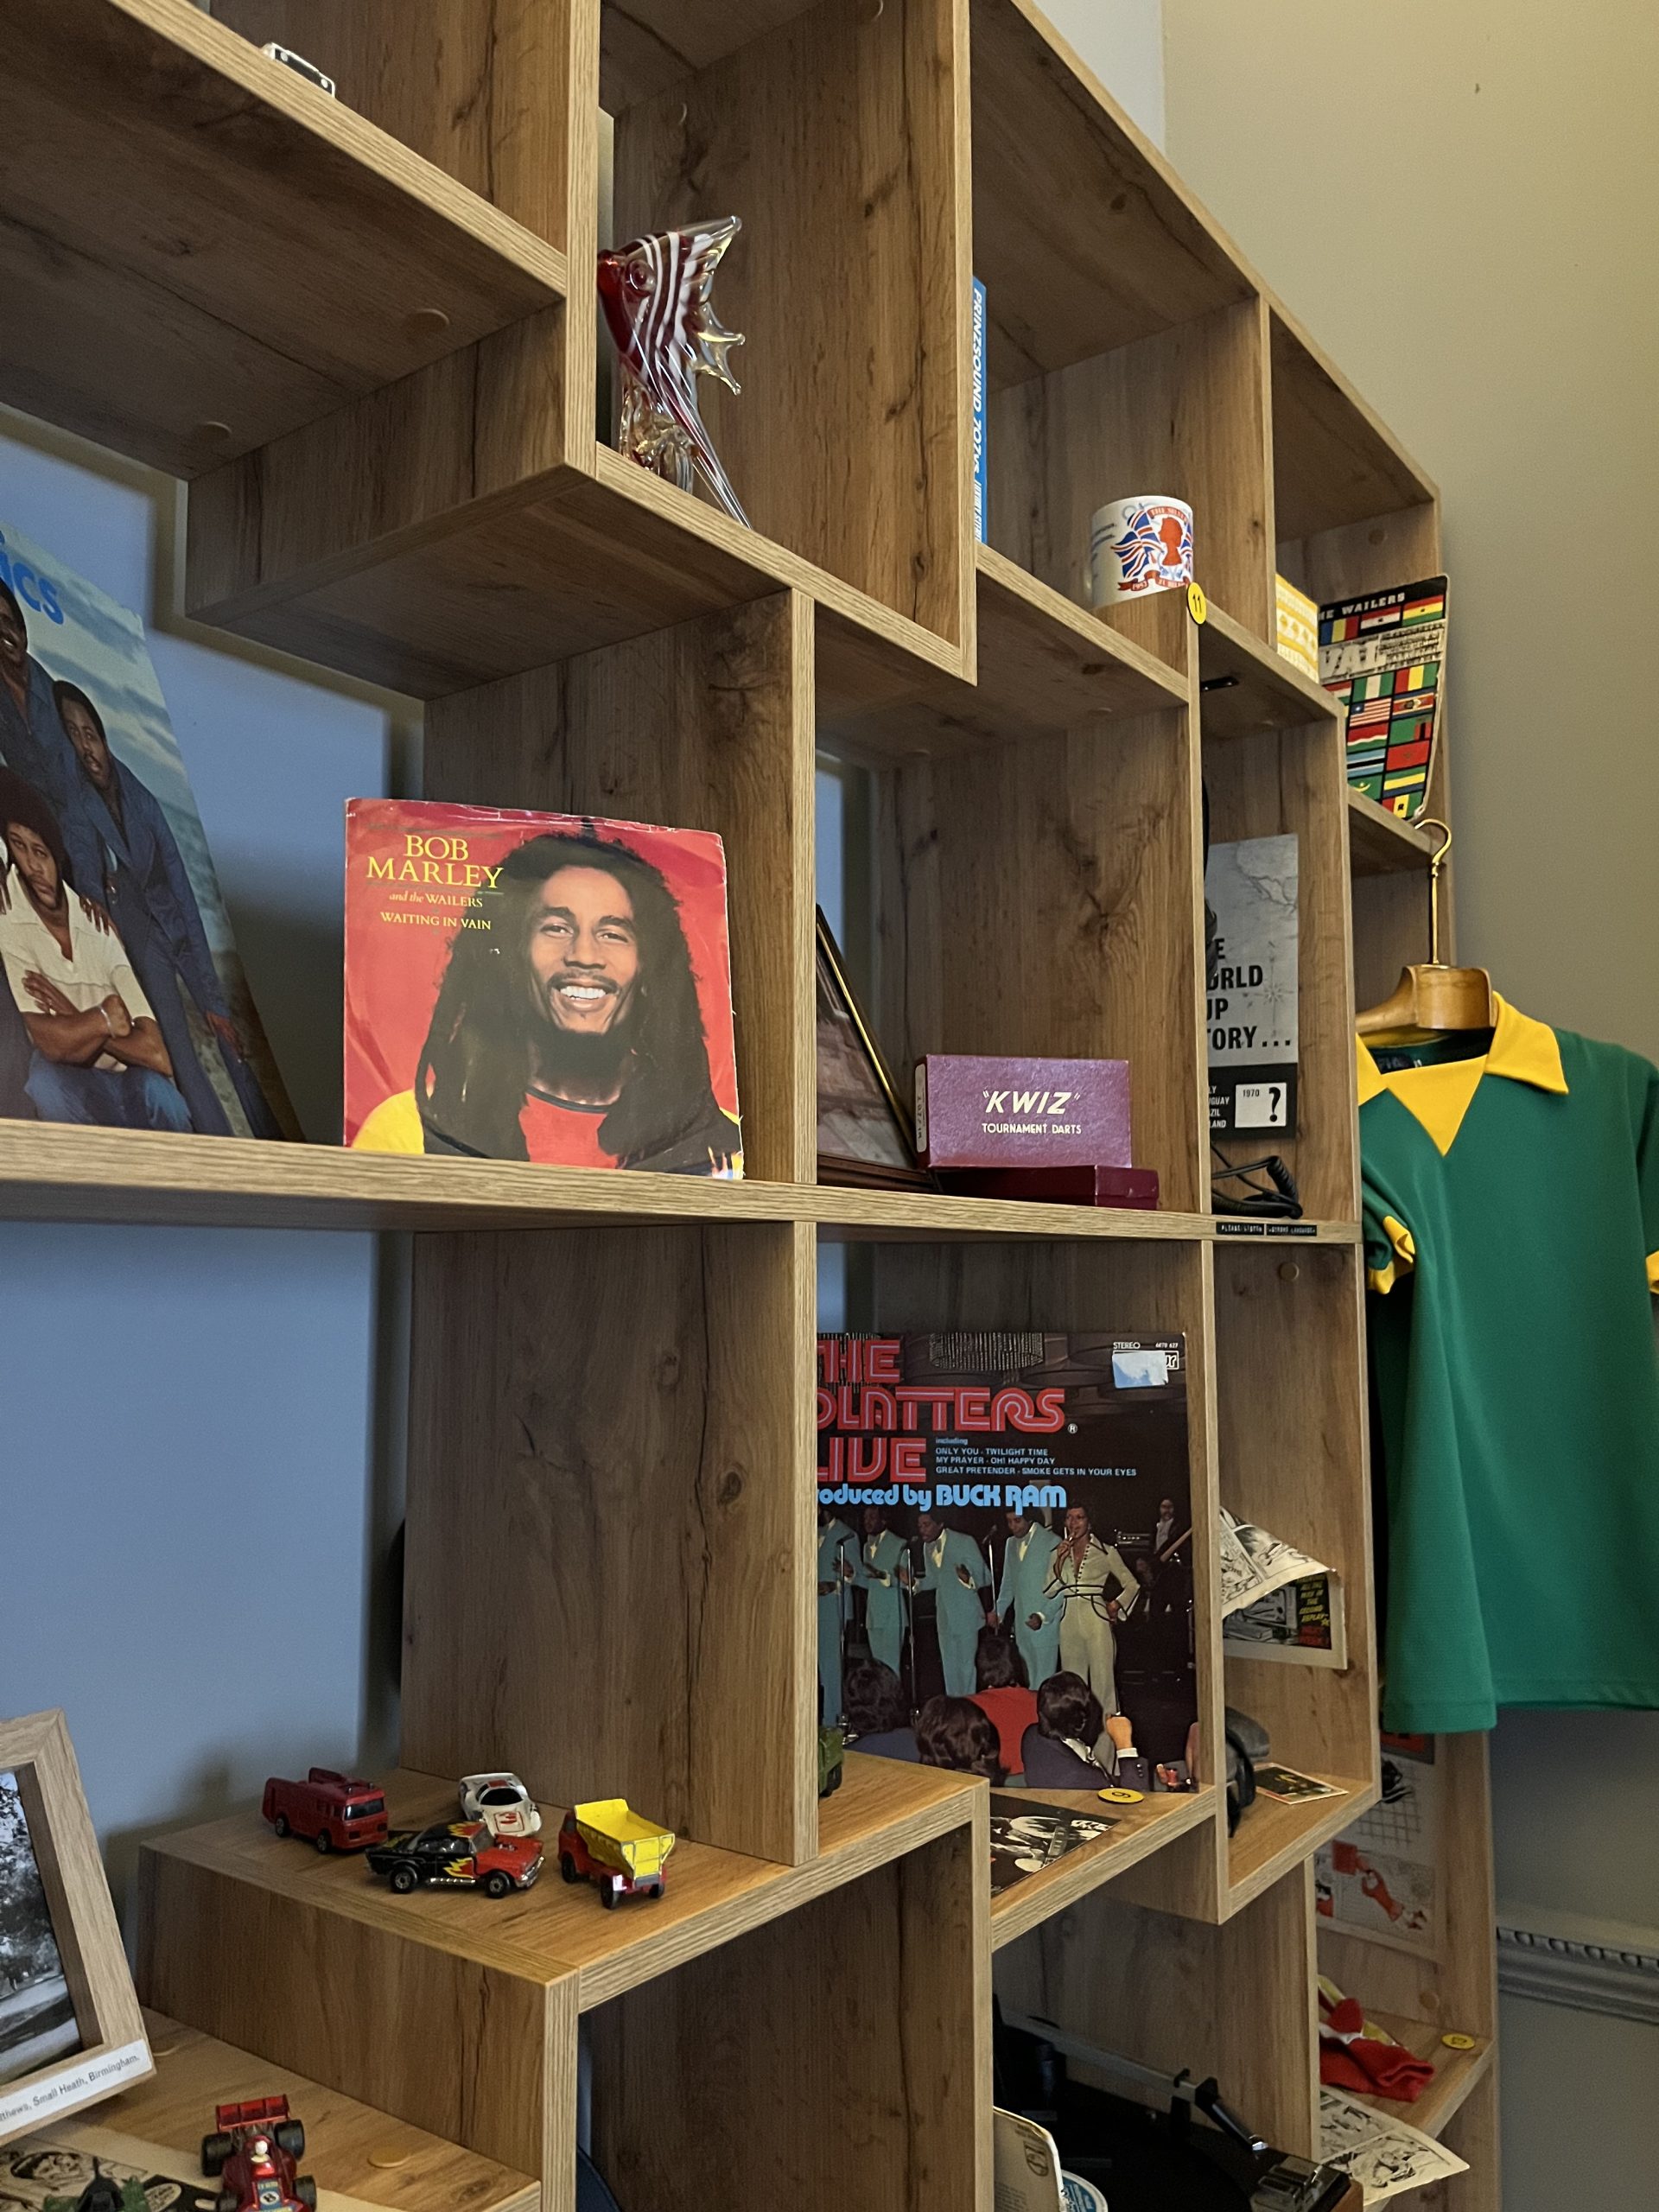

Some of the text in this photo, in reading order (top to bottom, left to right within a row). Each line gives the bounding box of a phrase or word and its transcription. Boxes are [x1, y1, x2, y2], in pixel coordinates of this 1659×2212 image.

[973, 288, 982, 412] PRINZSOUND
[1342, 592, 1406, 614] WAILERS
[404, 835, 468, 861] BOB
[366, 856, 505, 888] MARLEY
[389, 892, 483, 907] and the WAILERS
[380, 912, 491, 930] WAITING IN VAIN
[1208, 965, 1263, 990] ORLD
[982, 1123, 1082, 1135] TOURNAMENT DARTS
[817, 1437, 926, 1482] IVE
[817, 1484, 1066, 1515] oduced by BUCK RAM
[33, 2088, 58, 2106] Small
[60, 2075, 88, 2095] Heath,
[89, 2055, 139, 2082] Birmingham.
